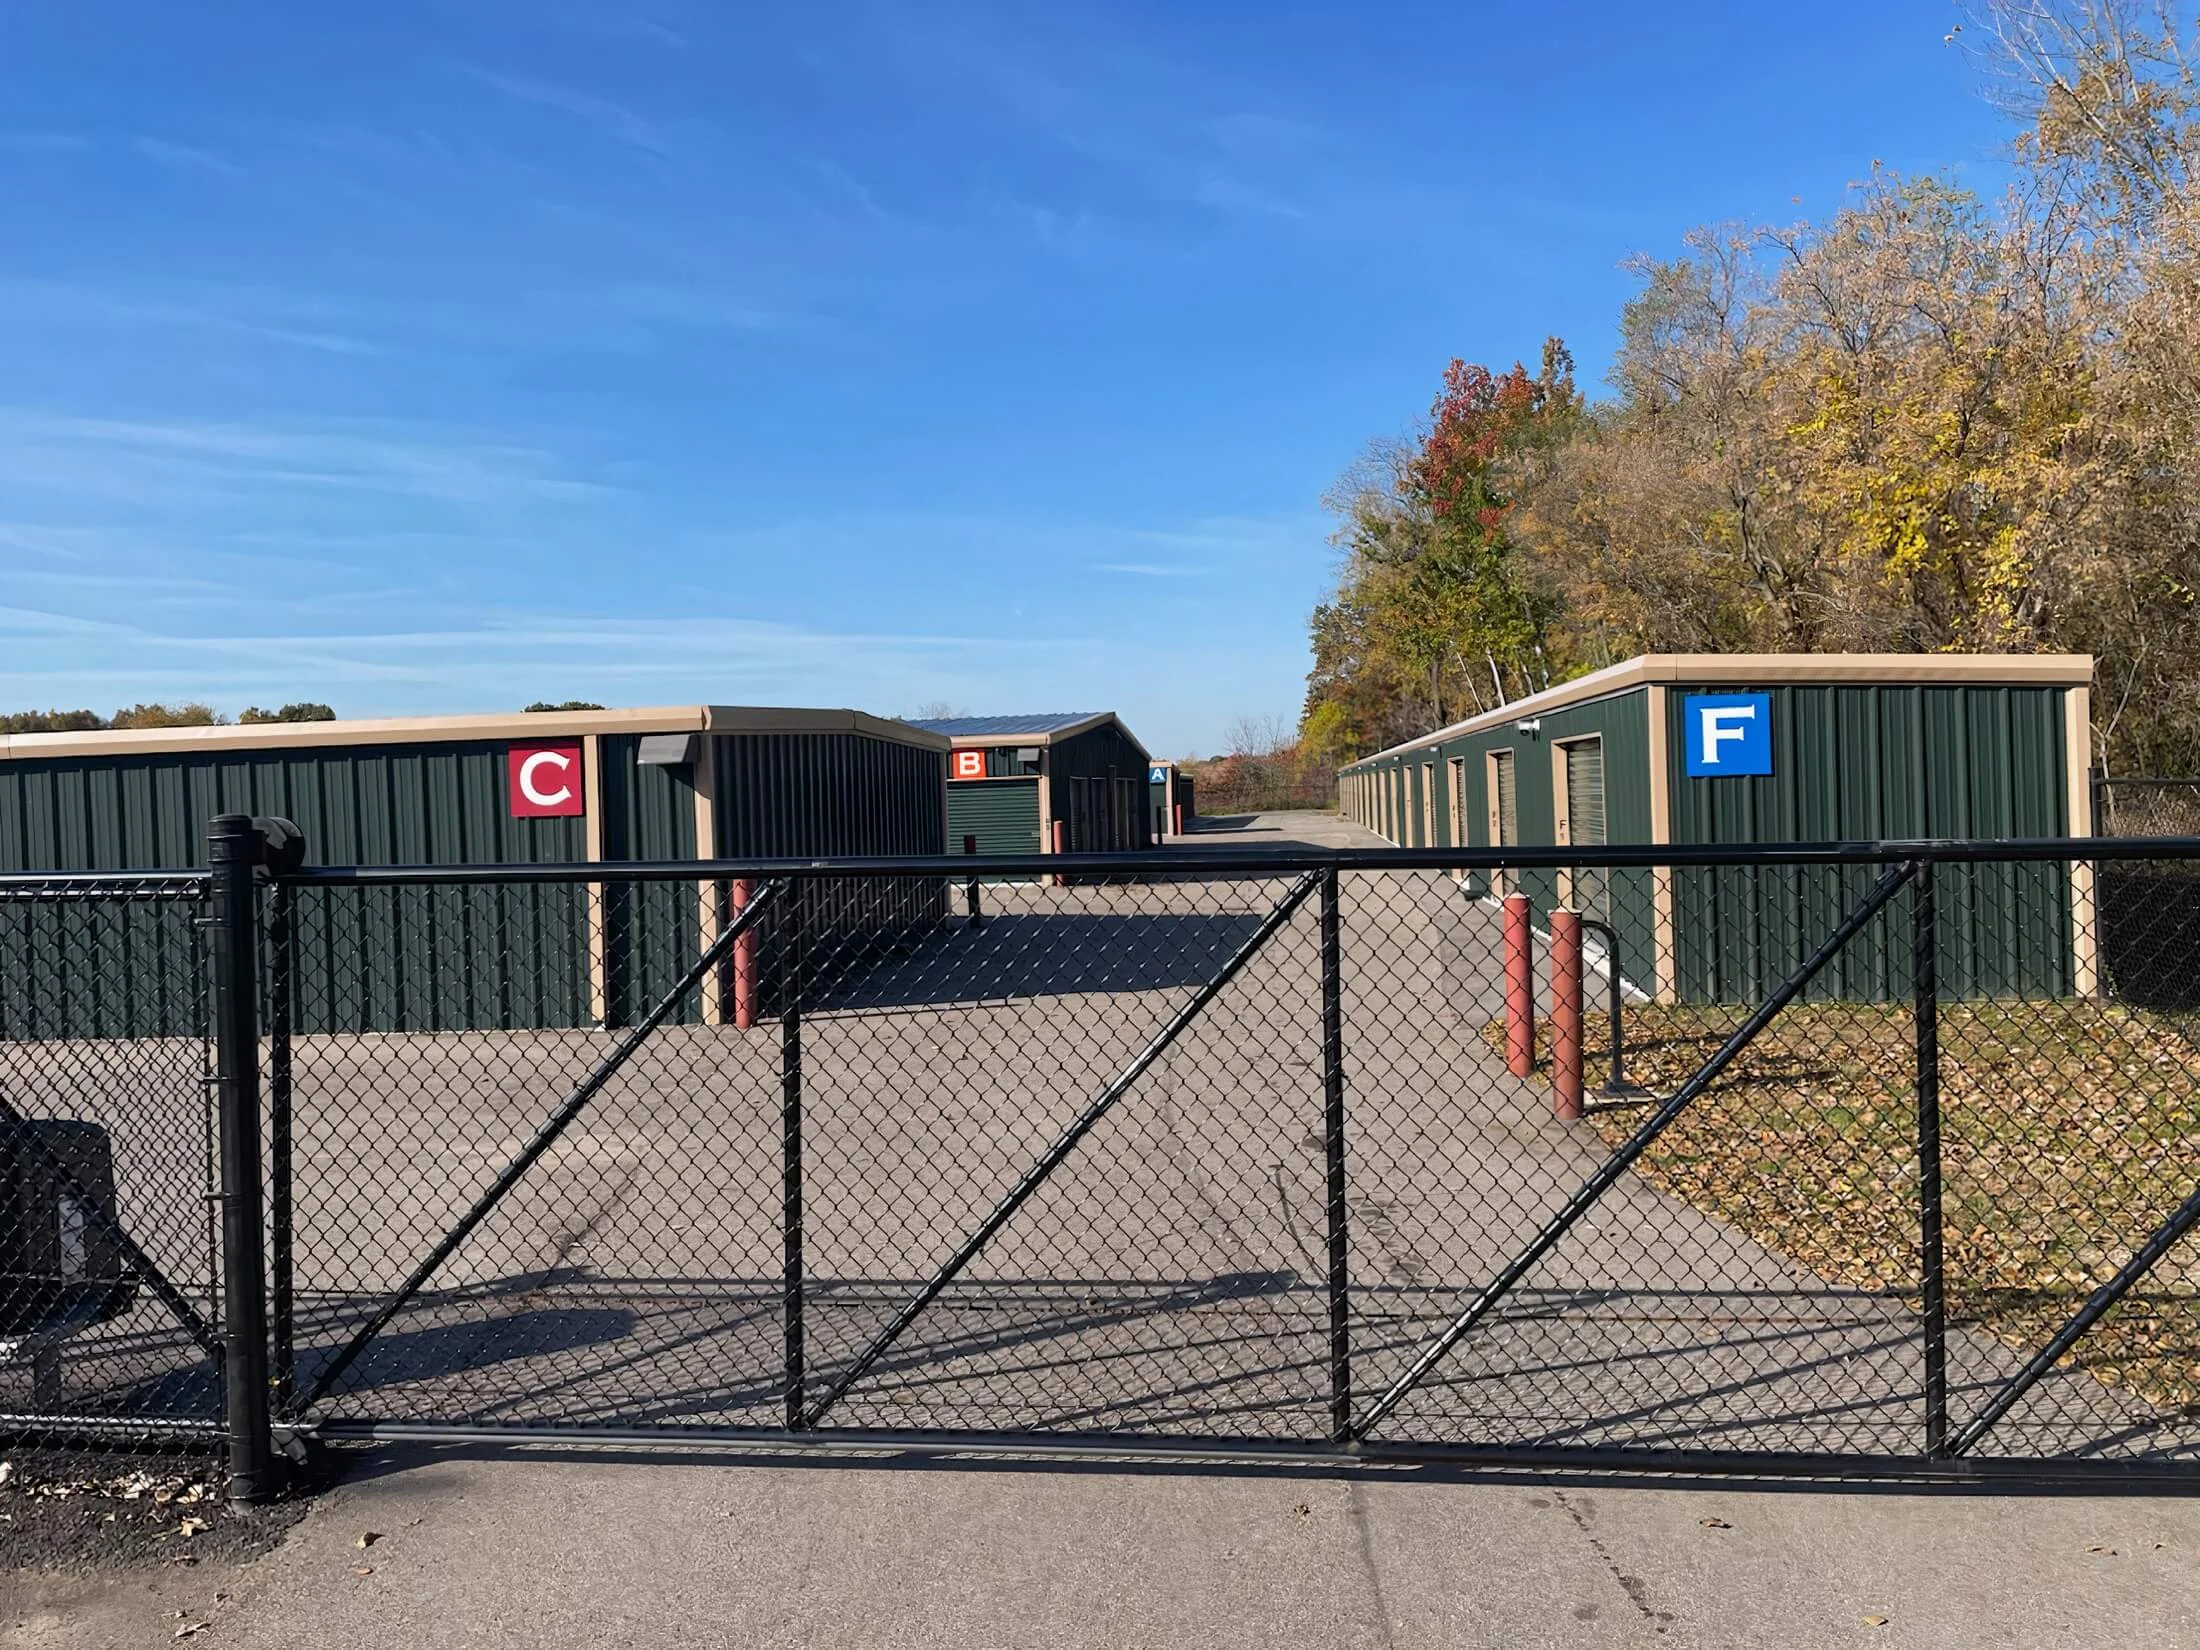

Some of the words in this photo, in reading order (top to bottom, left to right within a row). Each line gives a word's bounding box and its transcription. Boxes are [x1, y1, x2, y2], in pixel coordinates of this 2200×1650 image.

[1700, 704, 1755, 763] F
[519, 751, 572, 806] C
[959, 752, 981, 775] B
[1151, 767, 1166, 780] A
